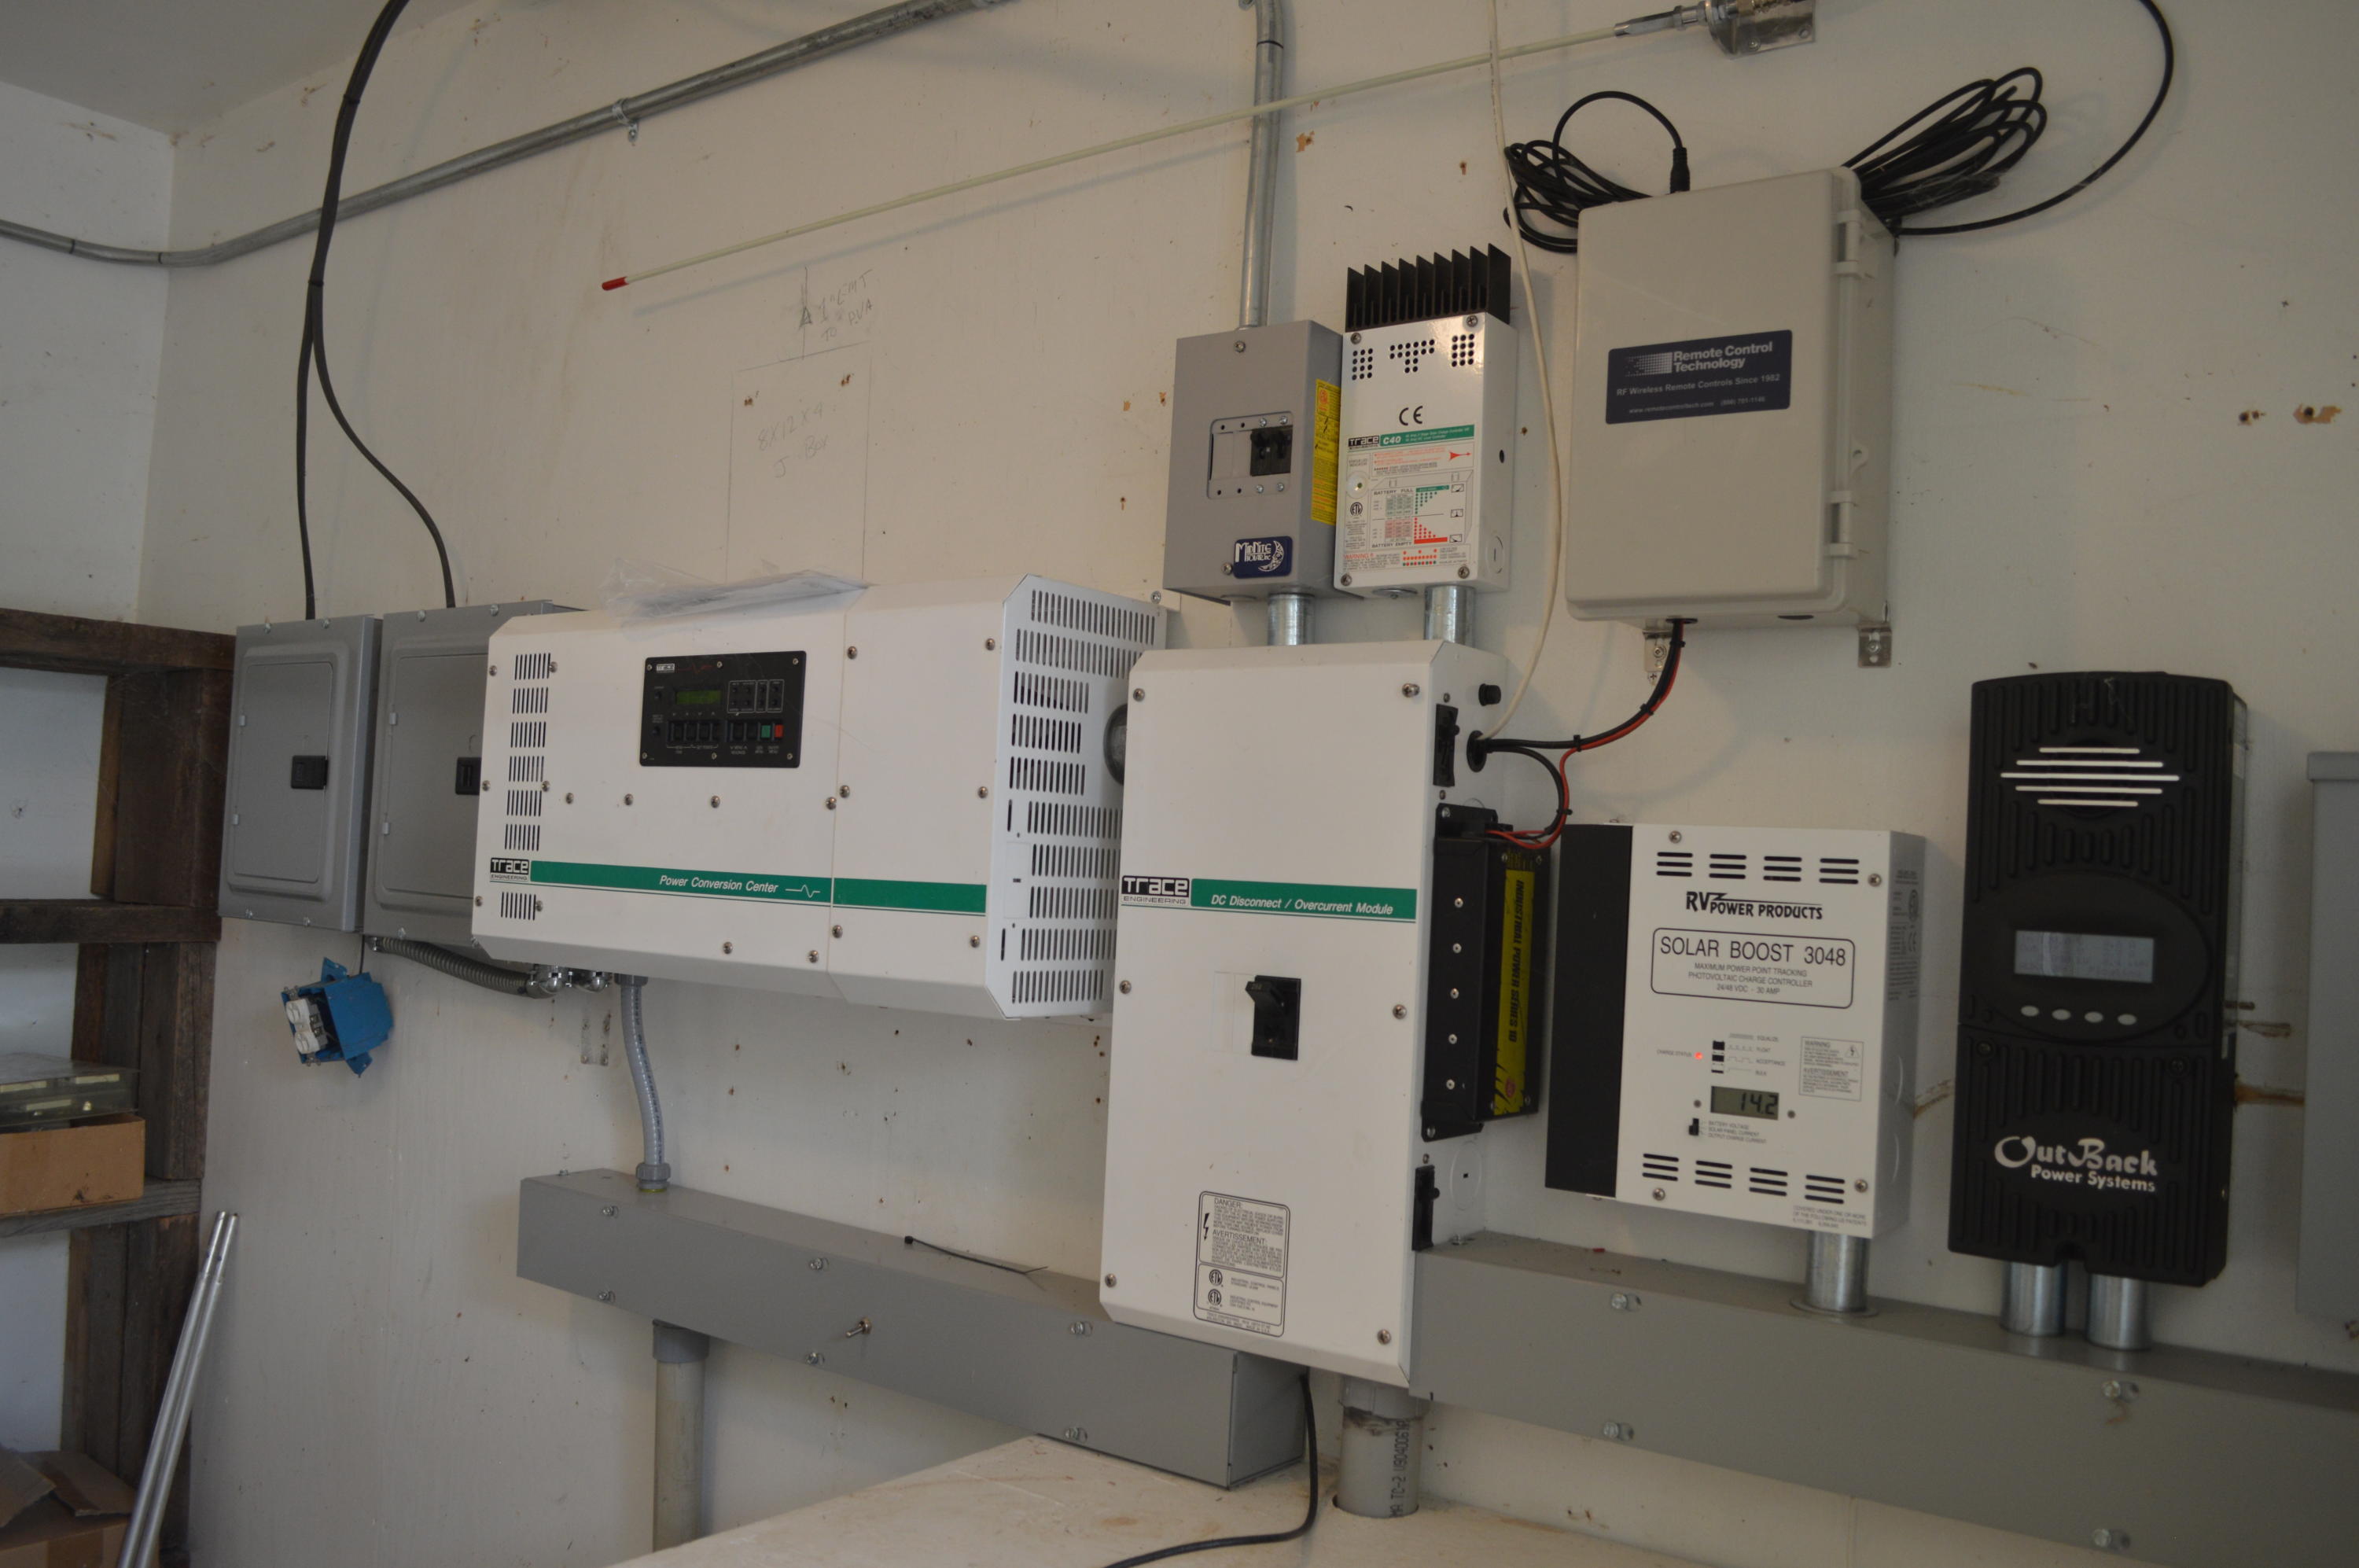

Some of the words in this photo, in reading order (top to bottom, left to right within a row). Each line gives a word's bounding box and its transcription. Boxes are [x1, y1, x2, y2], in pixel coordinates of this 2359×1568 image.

[1673, 348, 1723, 363] Remote
[1724, 341, 1773, 357] Control
[1673, 356, 1746, 374] Technology
[1616, 388, 1628, 396] RF
[1629, 385, 1663, 396] Wireless
[1665, 381, 1696, 392] Remote
[1698, 378, 1733, 389] Controls
[1735, 376, 1758, 385] Since
[1382, 435, 1402, 445] C40
[659, 874, 688, 888] Power
[690, 877, 743, 891] Conversion
[745, 880, 779, 893] Center
[1123, 896, 1187, 905] ENGINEERING
[1211, 894, 1226, 906] DC
[1228, 896, 1283, 909] Disconnect
[1294, 899, 1353, 914] Overcurrent
[1356, 903, 1394, 915] Module
[1709, 901, 1754, 918] POWER
[1757, 903, 1824, 920] PRODUCTS
[1513, 879, 1525, 945] INDUSTRIAL
[1659, 936, 1720, 958] SOLAR
[1729, 940, 1794, 963] BOOST
[1803, 946, 1846, 967] 3048
[1511, 948, 1522, 988] POWER
[1694, 962, 1725, 972] MAXIMUM
[1726, 964, 1751, 974] POWER
[1751, 966, 1772, 974] POINT
[1773, 967, 1807, 977] TRACKING
[1687, 972, 1738, 982] PHOTOVOLTAIC
[1739, 975, 1767, 985] CHARGE
[1768, 977, 1813, 988] CONTROLLER
[1734, 985, 1748, 993] VDC
[1510, 989, 1520, 1027] SERIES
[1740, 1091, 1779, 1116] 14.2
[2030, 1164, 2082, 1183] Power
[2087, 1170, 2156, 1193] Systems
